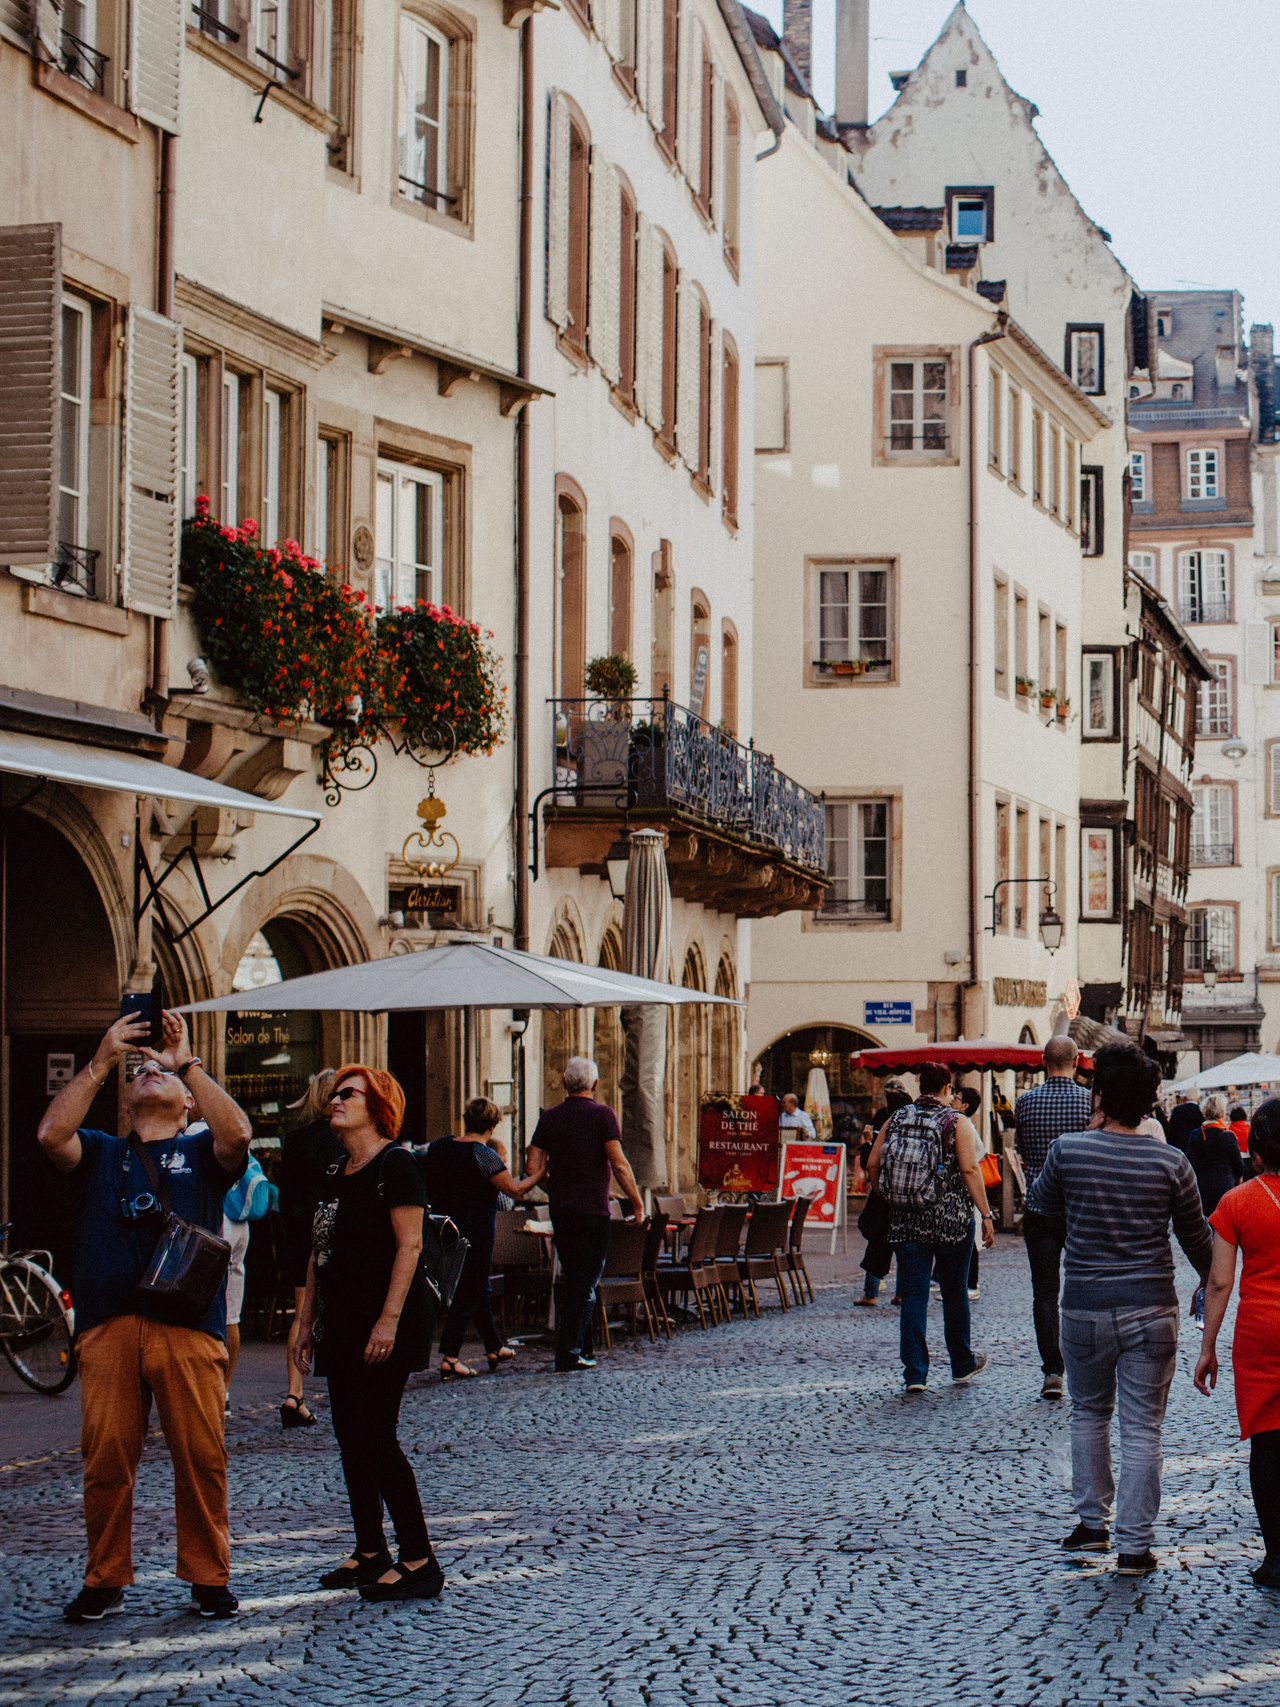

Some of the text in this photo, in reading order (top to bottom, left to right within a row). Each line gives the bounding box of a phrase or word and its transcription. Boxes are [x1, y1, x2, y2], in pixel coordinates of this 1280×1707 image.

[407, 888, 453, 911] Christian
[227, 1026, 290, 1044] Salon de Thé
[722, 1109, 758, 1120] SALON
[721, 1120, 759, 1131] DE THÉ
[709, 1141, 770, 1152] RESTAURANT
